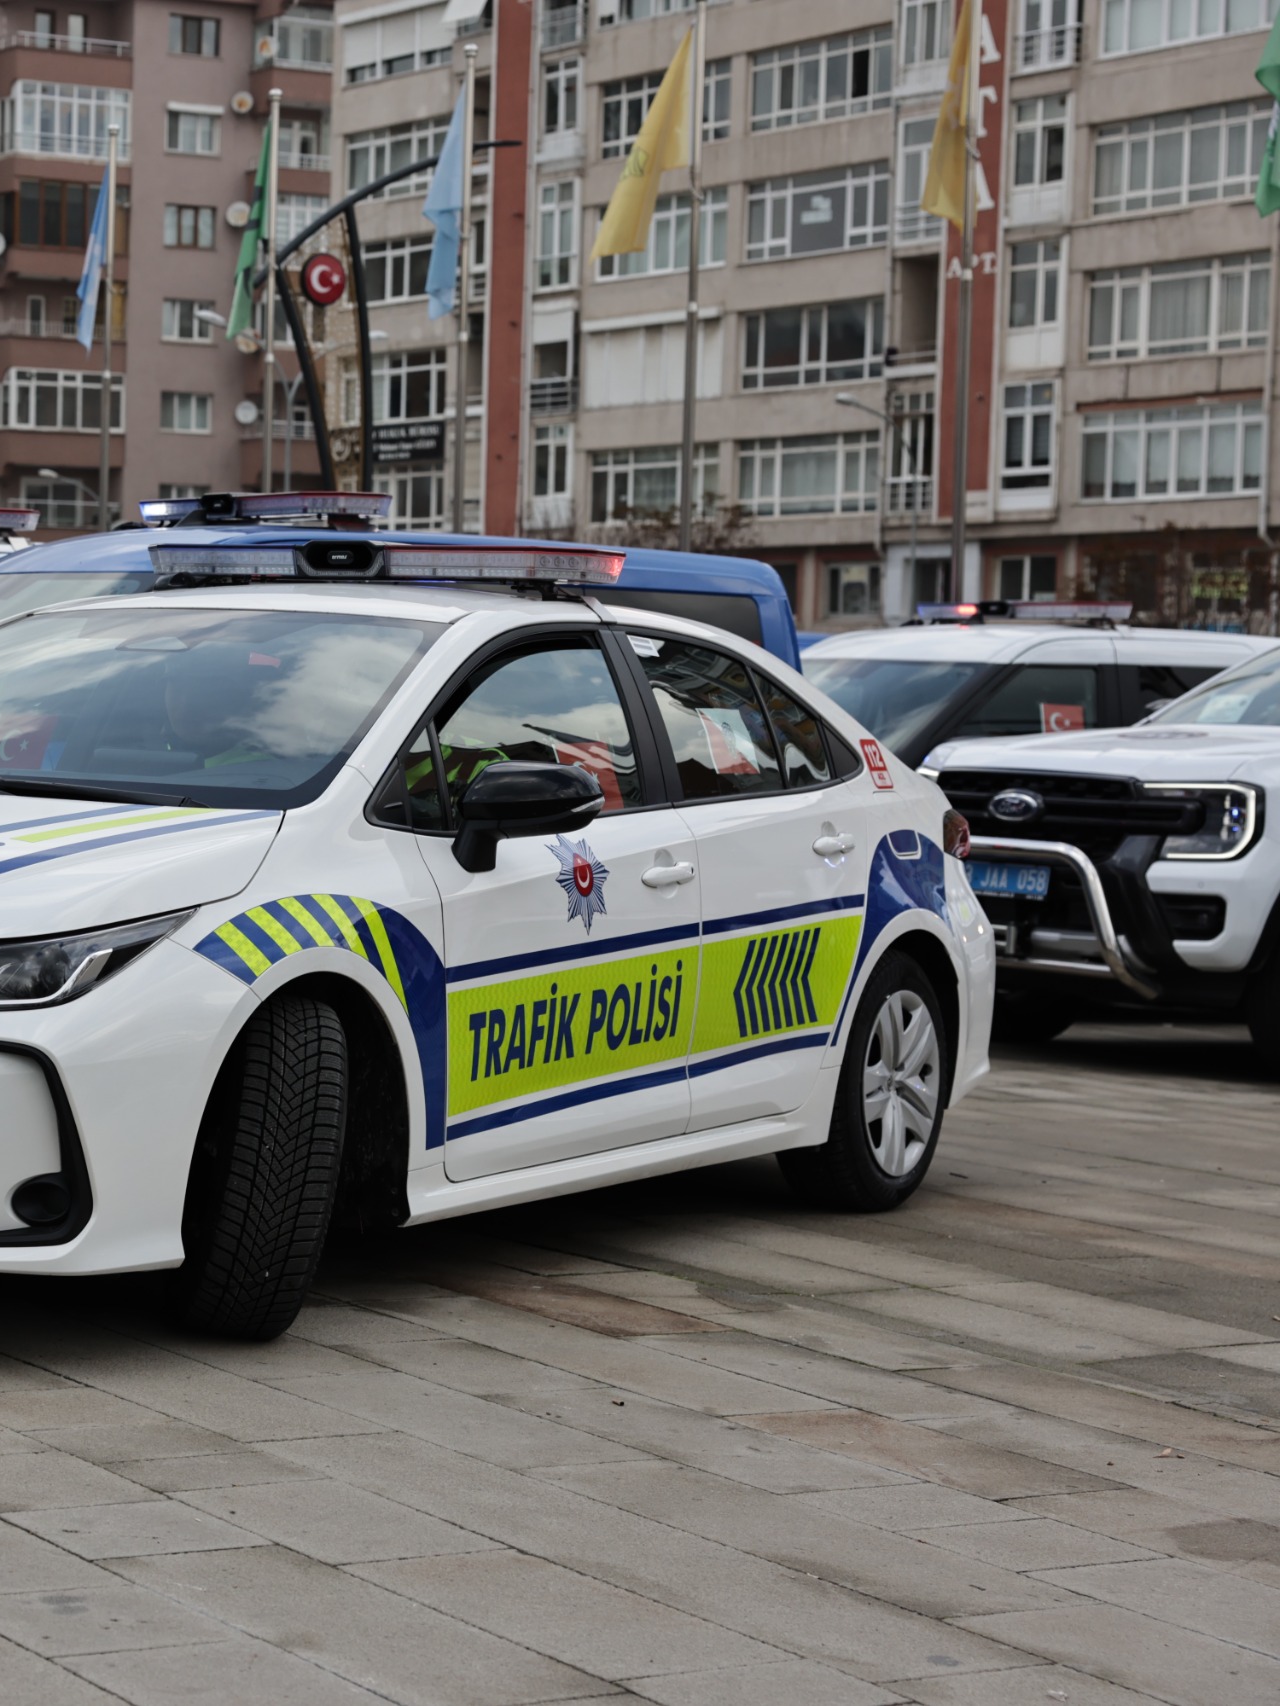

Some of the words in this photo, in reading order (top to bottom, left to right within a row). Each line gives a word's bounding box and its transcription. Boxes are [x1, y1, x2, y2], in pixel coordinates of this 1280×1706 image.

[863, 744, 885, 768] 112
[980, 867, 1008, 889] JAA
[1017, 868, 1047, 892] 058
[469, 982, 581, 1082] TRAFİK
[585, 959, 683, 1055] POLİSİ
